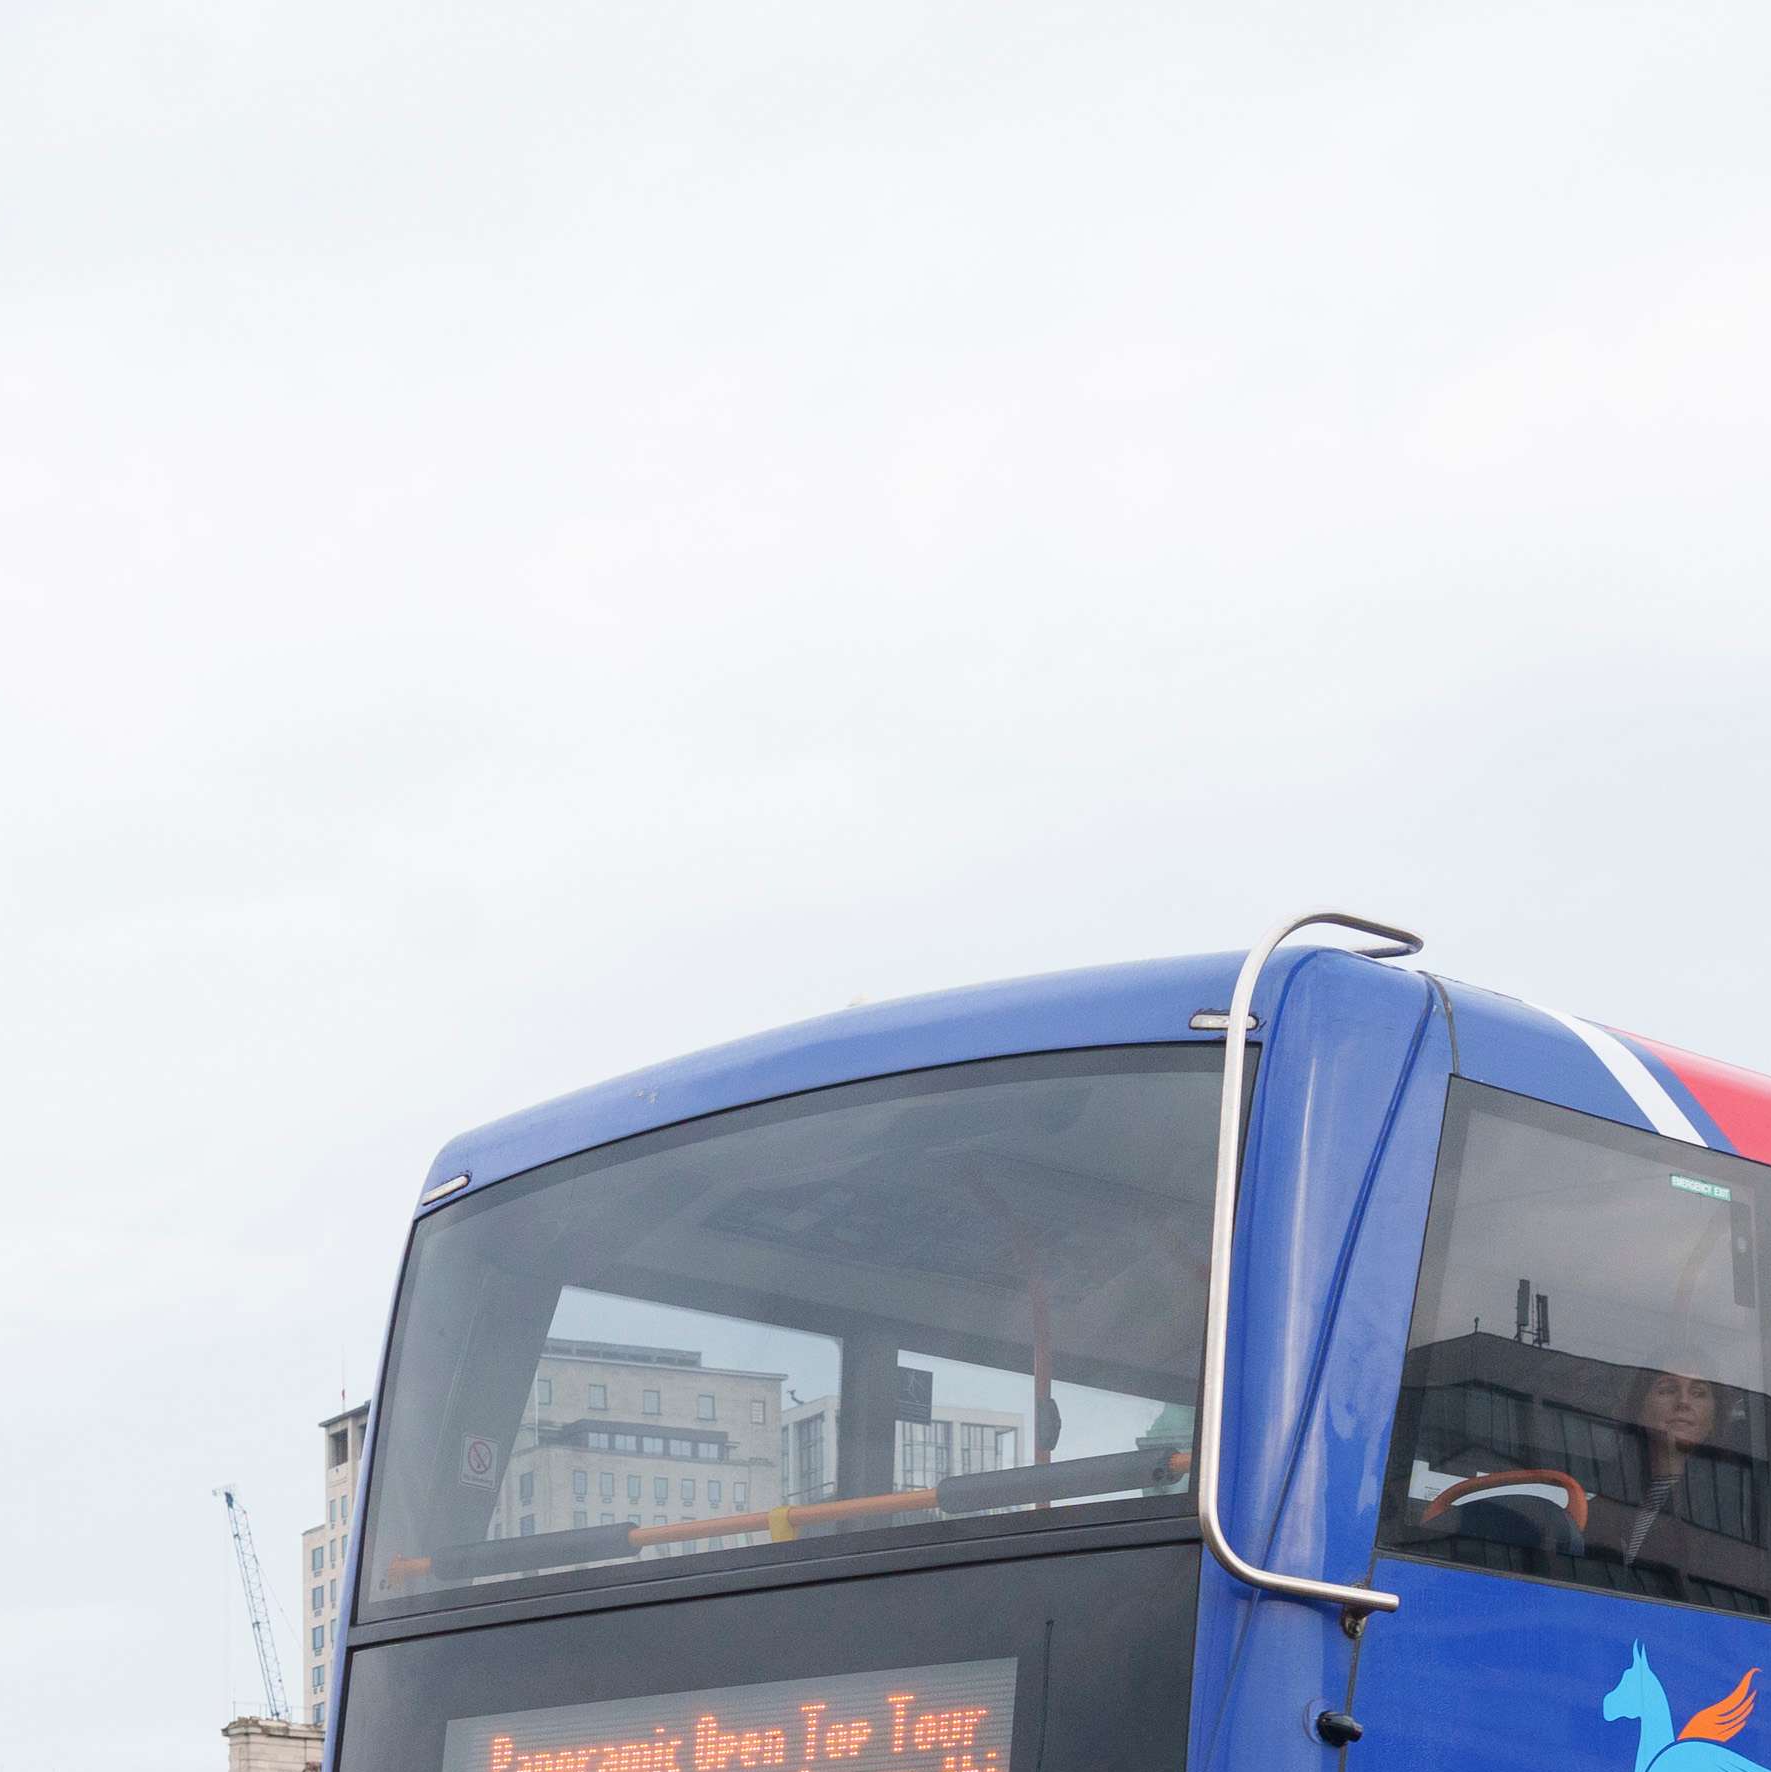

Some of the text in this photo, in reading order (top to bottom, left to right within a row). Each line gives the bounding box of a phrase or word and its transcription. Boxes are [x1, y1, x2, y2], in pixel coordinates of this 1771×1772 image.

[693, 1714, 785, 1772] Open
[800, 1703, 872, 1761] Top
[887, 1694, 989, 1753] Tour
